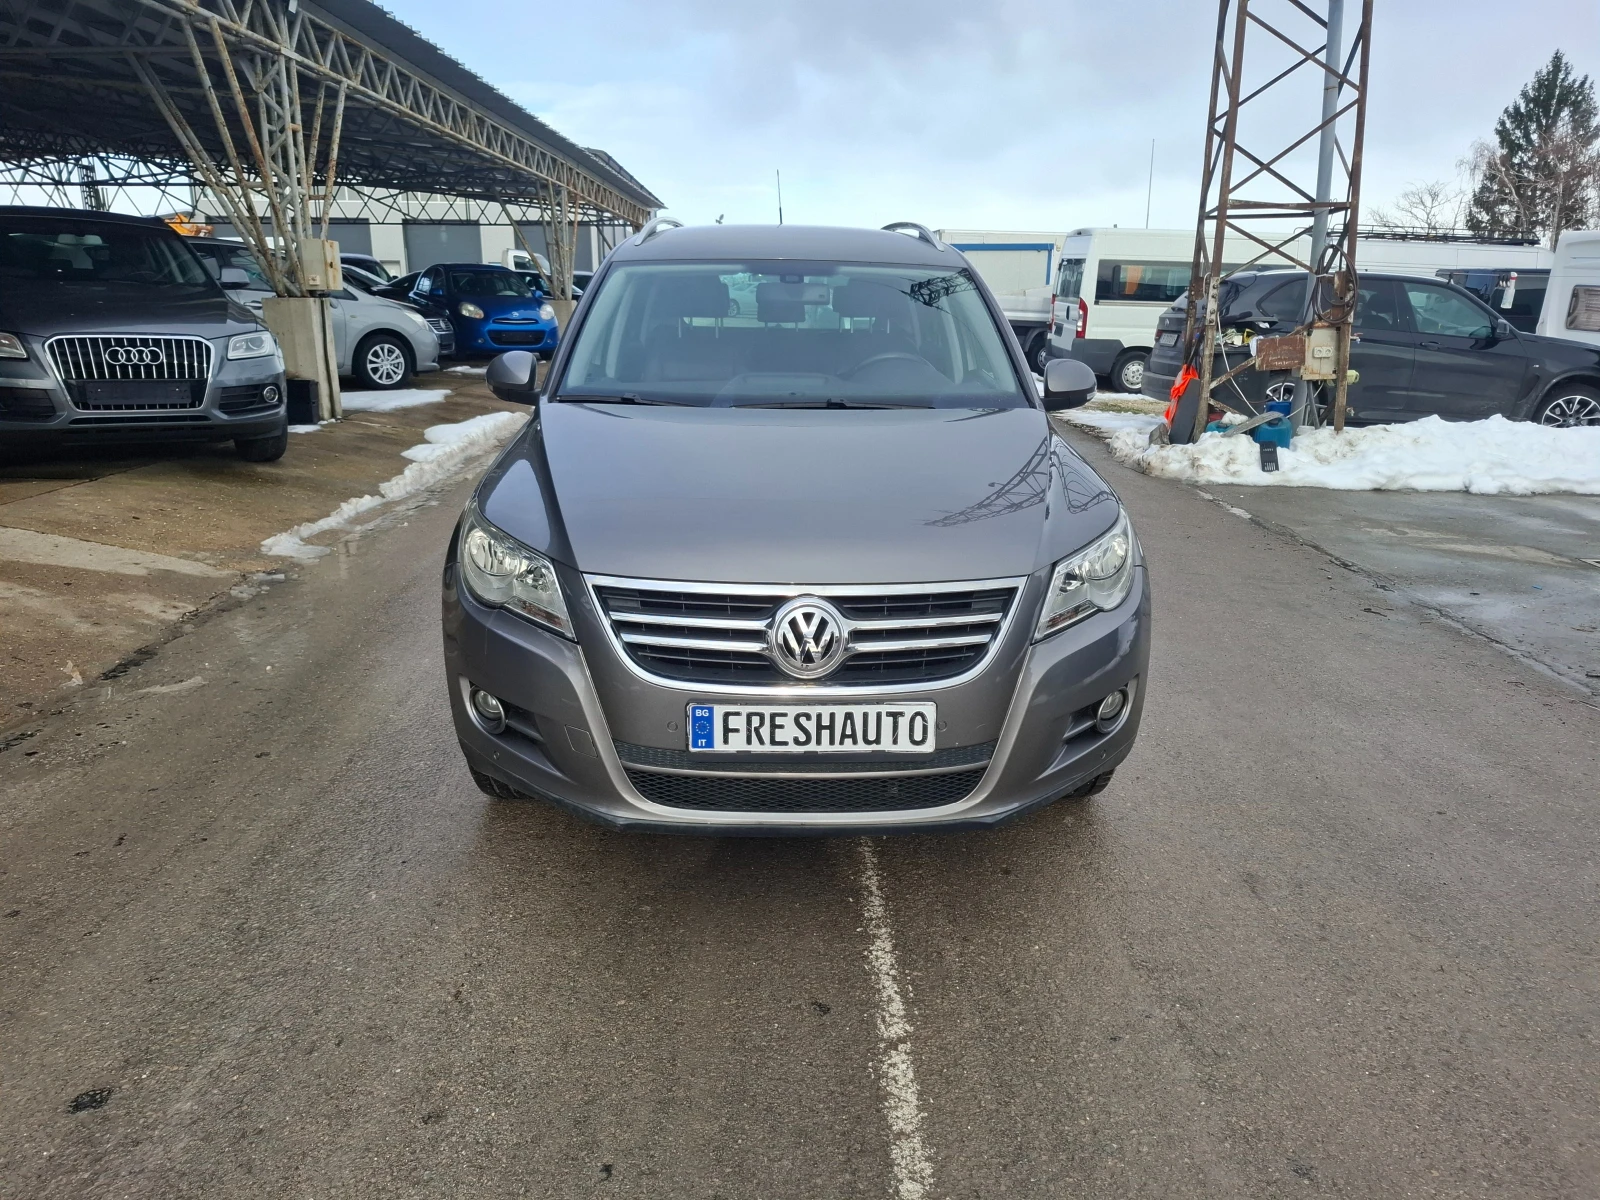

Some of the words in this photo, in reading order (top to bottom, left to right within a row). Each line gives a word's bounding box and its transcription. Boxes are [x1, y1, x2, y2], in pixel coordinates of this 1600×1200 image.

[778, 607, 839, 669] VW
[695, 709, 709, 717] BG
[722, 711, 929, 746] FRESHAUTO
[698, 739, 707, 747] IT
